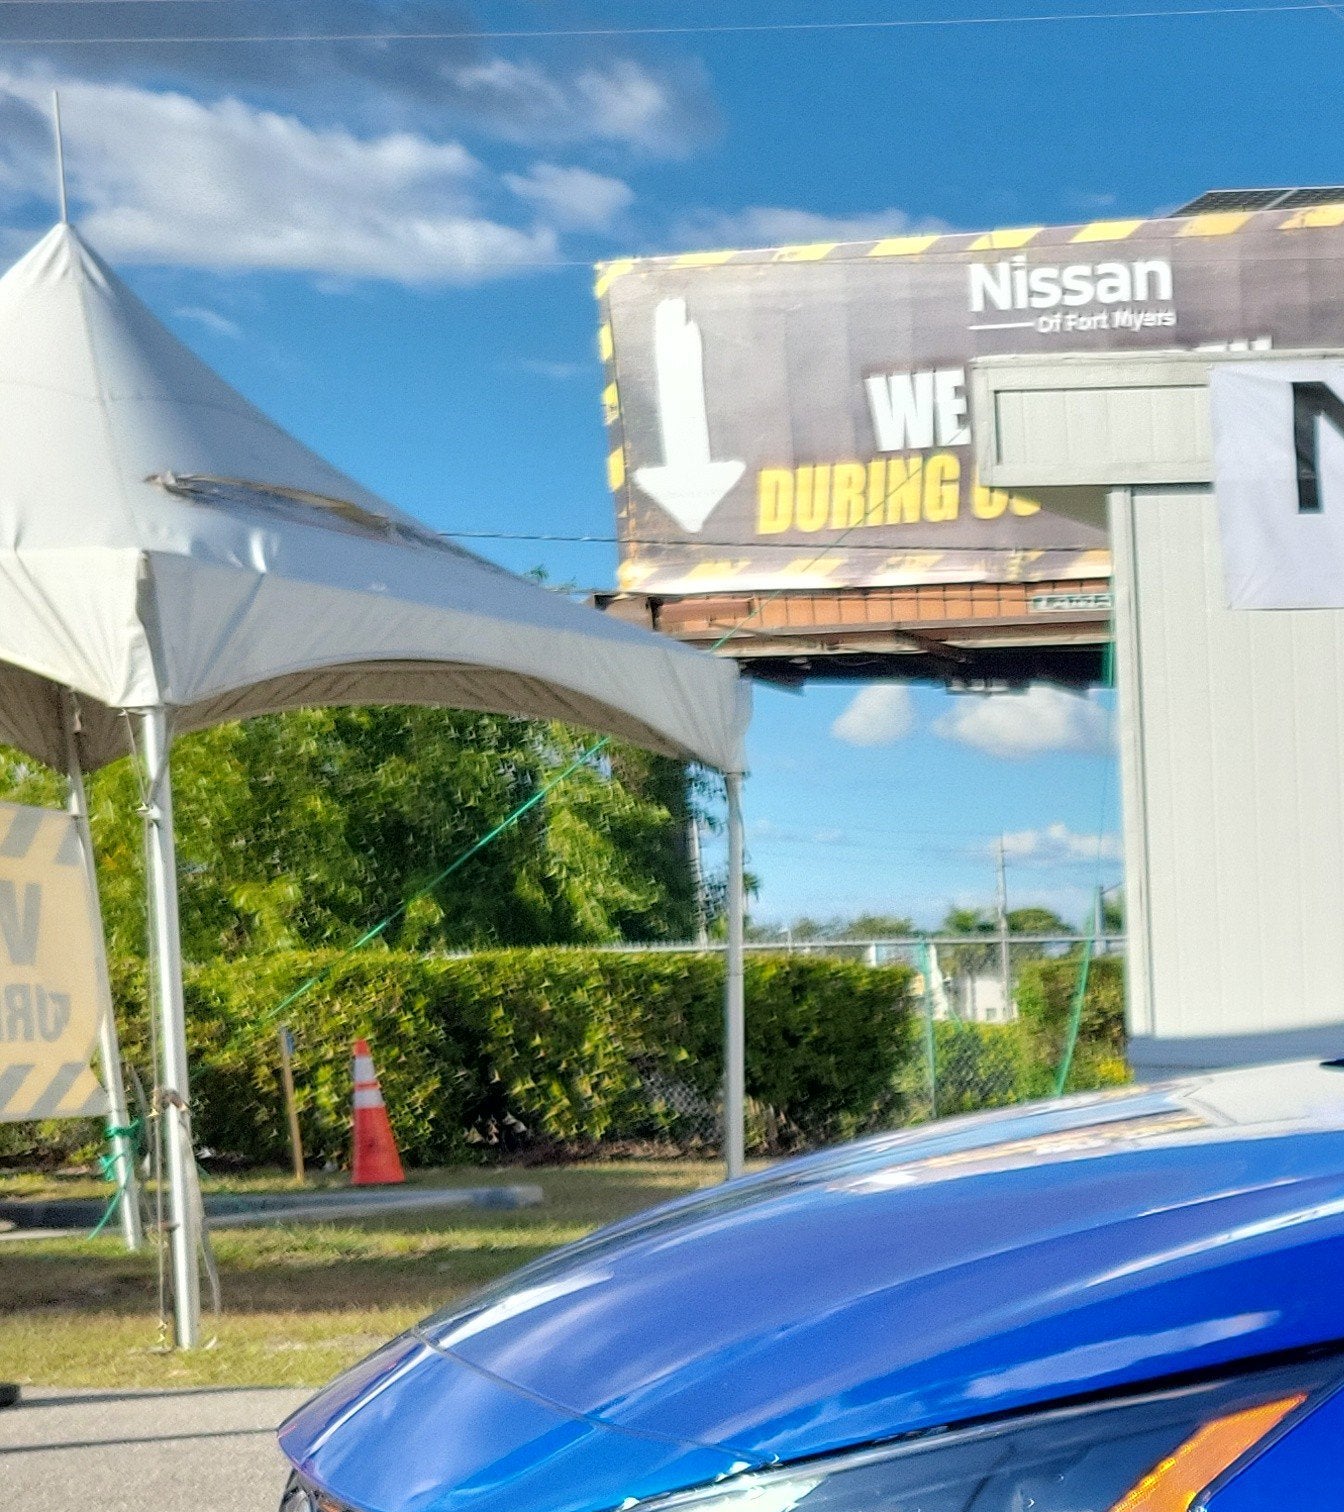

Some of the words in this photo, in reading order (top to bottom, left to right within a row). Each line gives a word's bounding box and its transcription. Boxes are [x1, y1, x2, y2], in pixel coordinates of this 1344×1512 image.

[968, 255, 1173, 311] Nissan
[1036, 312, 1061, 332] Of
[1065, 309, 1108, 331] Fort
[1113, 307, 1177, 332] Myers
[757, 455, 958, 534] DURING
